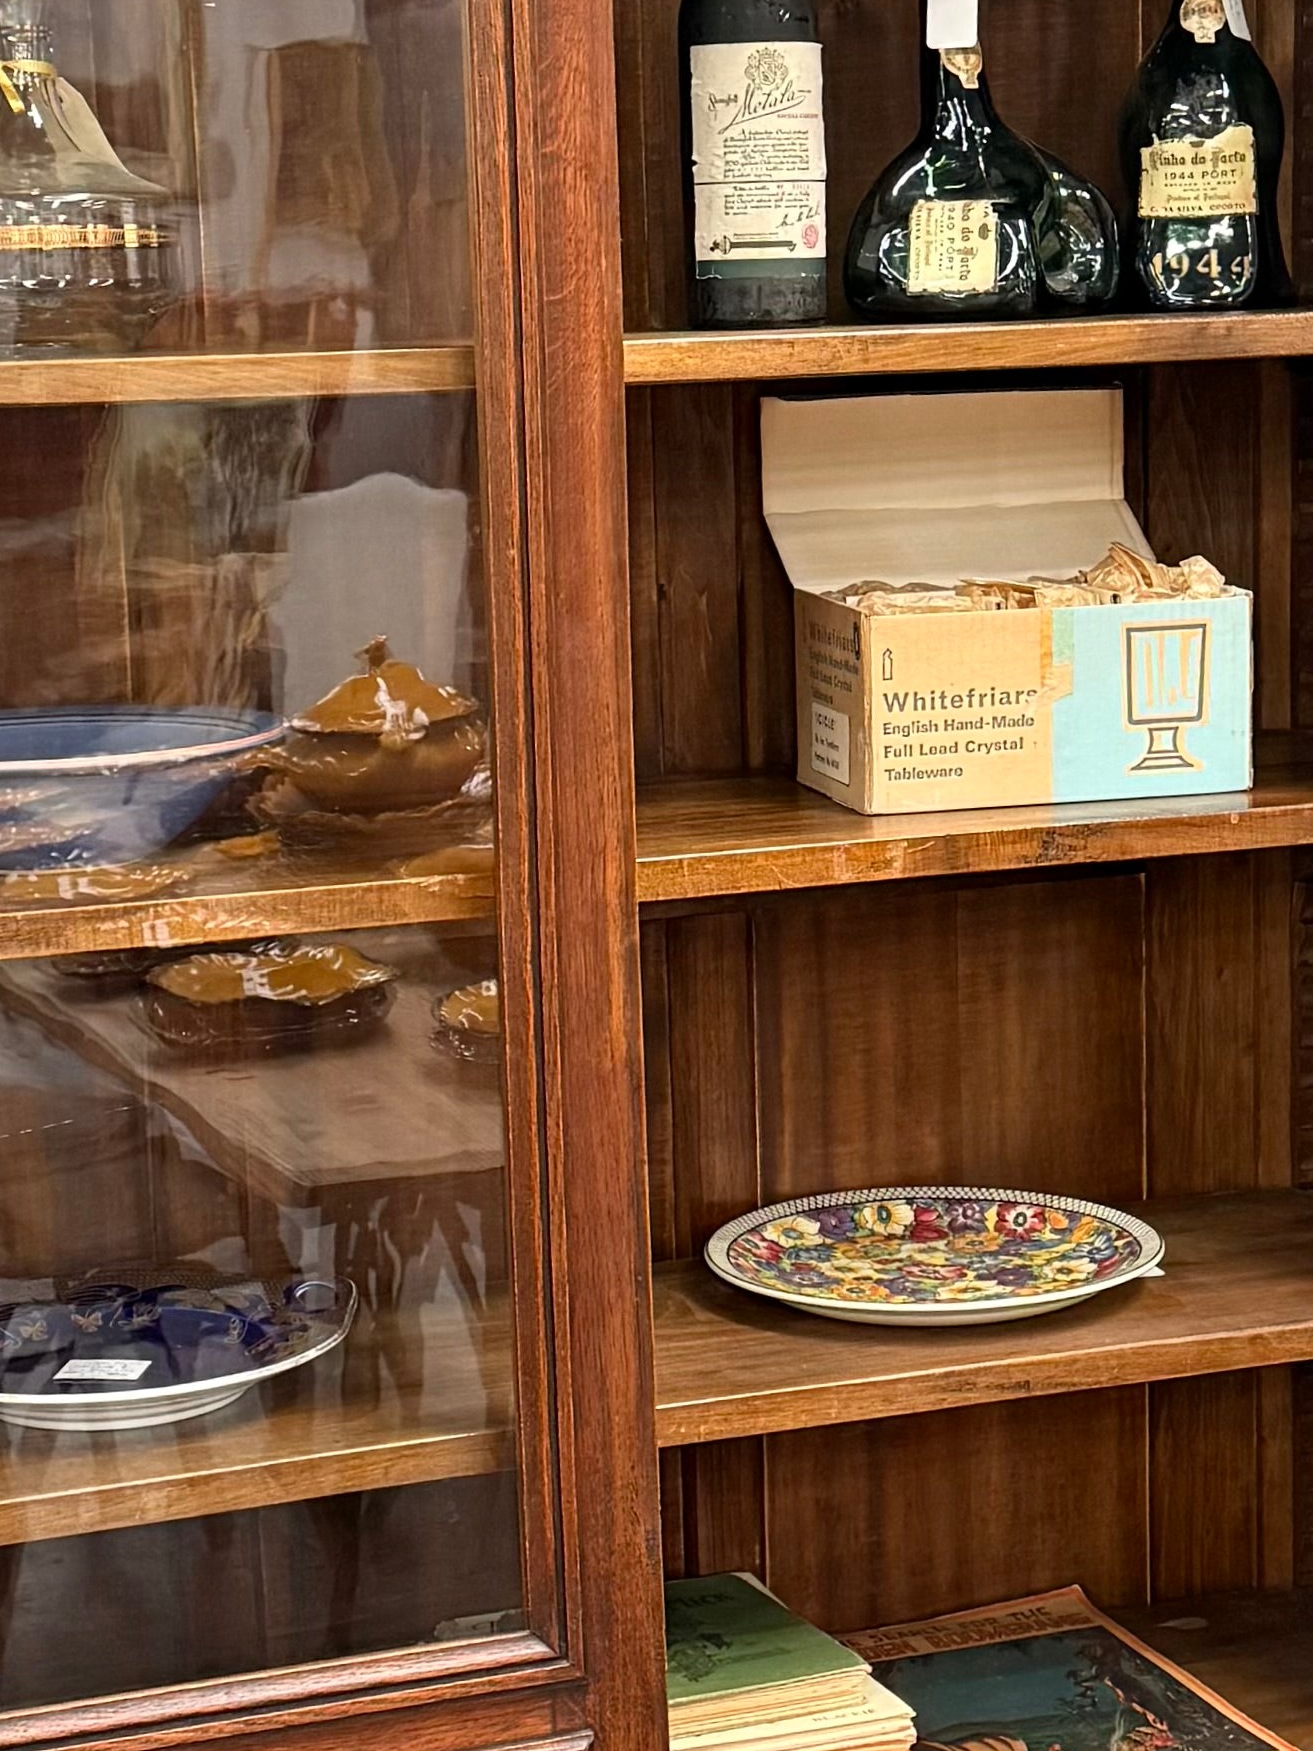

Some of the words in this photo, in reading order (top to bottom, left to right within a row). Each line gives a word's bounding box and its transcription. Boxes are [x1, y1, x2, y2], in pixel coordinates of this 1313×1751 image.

[1164, 171, 1194, 180] 1944
[1202, 169, 1237, 179] PORT
[946, 237, 956, 271] PORT
[882, 686, 1038, 713] Whitefriars
[883, 720, 939, 738] English
[943, 714, 1035, 732] Hand-Made
[884, 744, 913, 759] Full
[919, 741, 959, 756] Lead
[964, 736, 1024, 755] Crystal
[884, 766, 964, 782] Tableware
